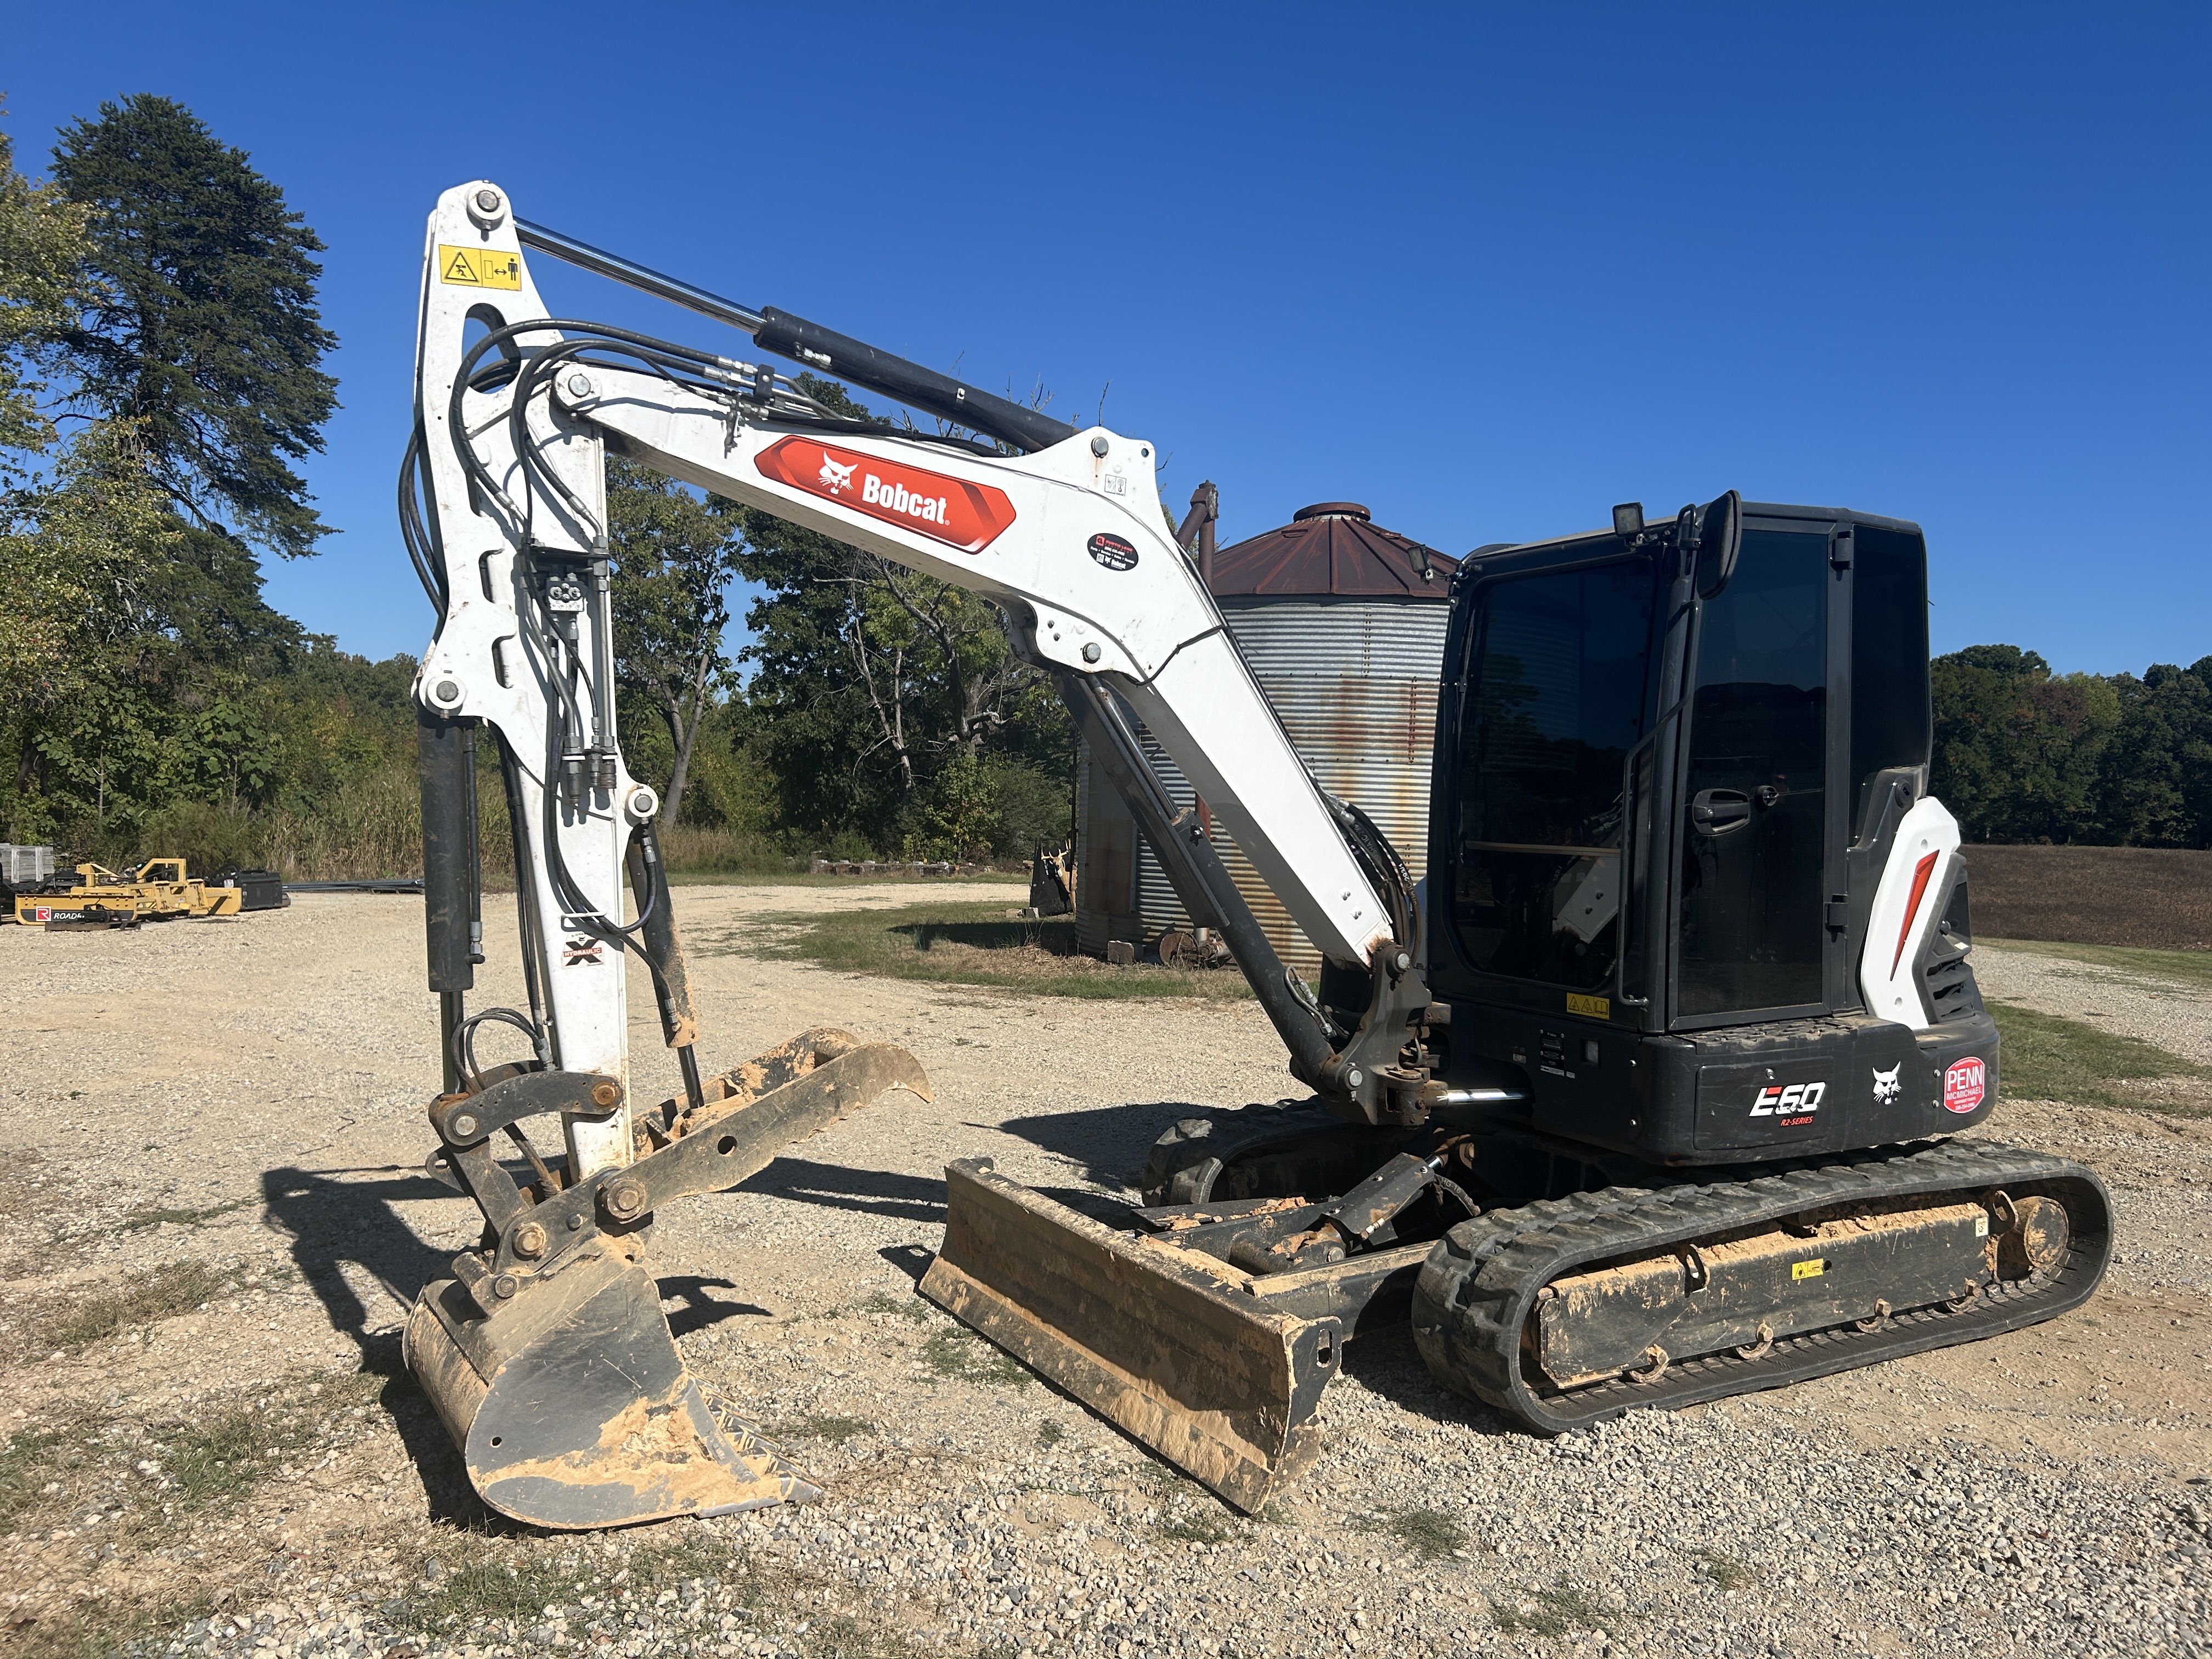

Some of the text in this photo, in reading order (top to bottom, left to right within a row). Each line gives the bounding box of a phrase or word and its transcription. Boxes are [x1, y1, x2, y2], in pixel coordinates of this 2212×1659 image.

[862, 473, 947, 524] Bobcat
[564, 948, 601, 957] HYDRAULIC
[1947, 1064, 1983, 1092] PENN
[1749, 1081, 1826, 1117] E60
[1780, 1116, 1814, 1127] R2-SERIES
